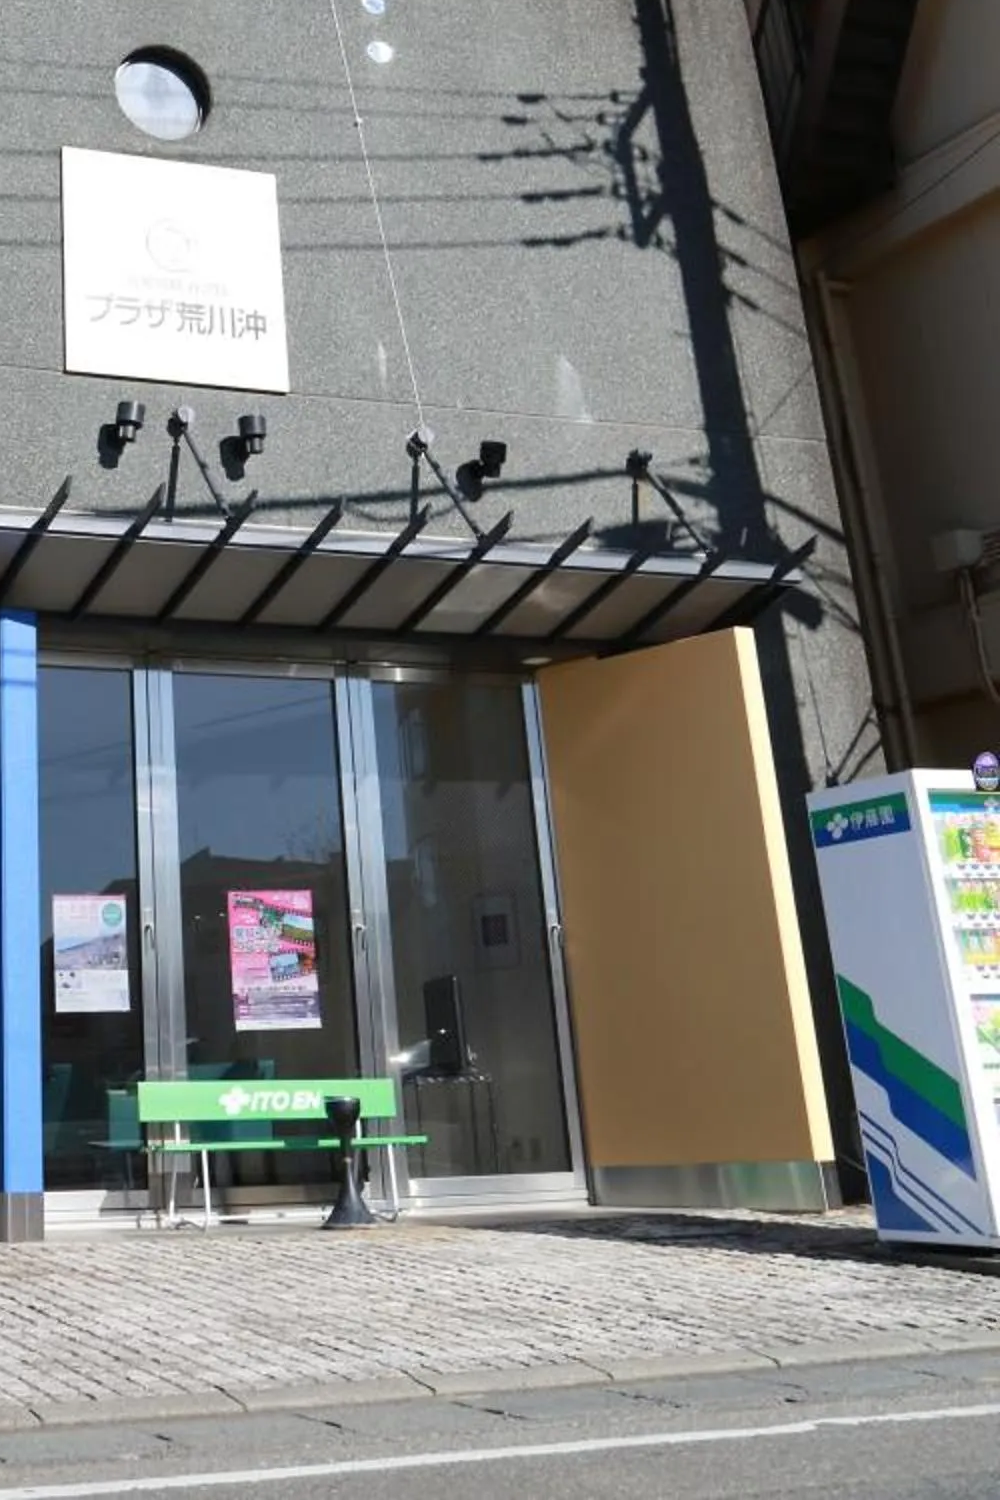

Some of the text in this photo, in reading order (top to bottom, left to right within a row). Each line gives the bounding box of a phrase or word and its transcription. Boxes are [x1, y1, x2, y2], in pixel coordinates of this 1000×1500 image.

[85, 292, 267, 340] プラザ荒川沖
